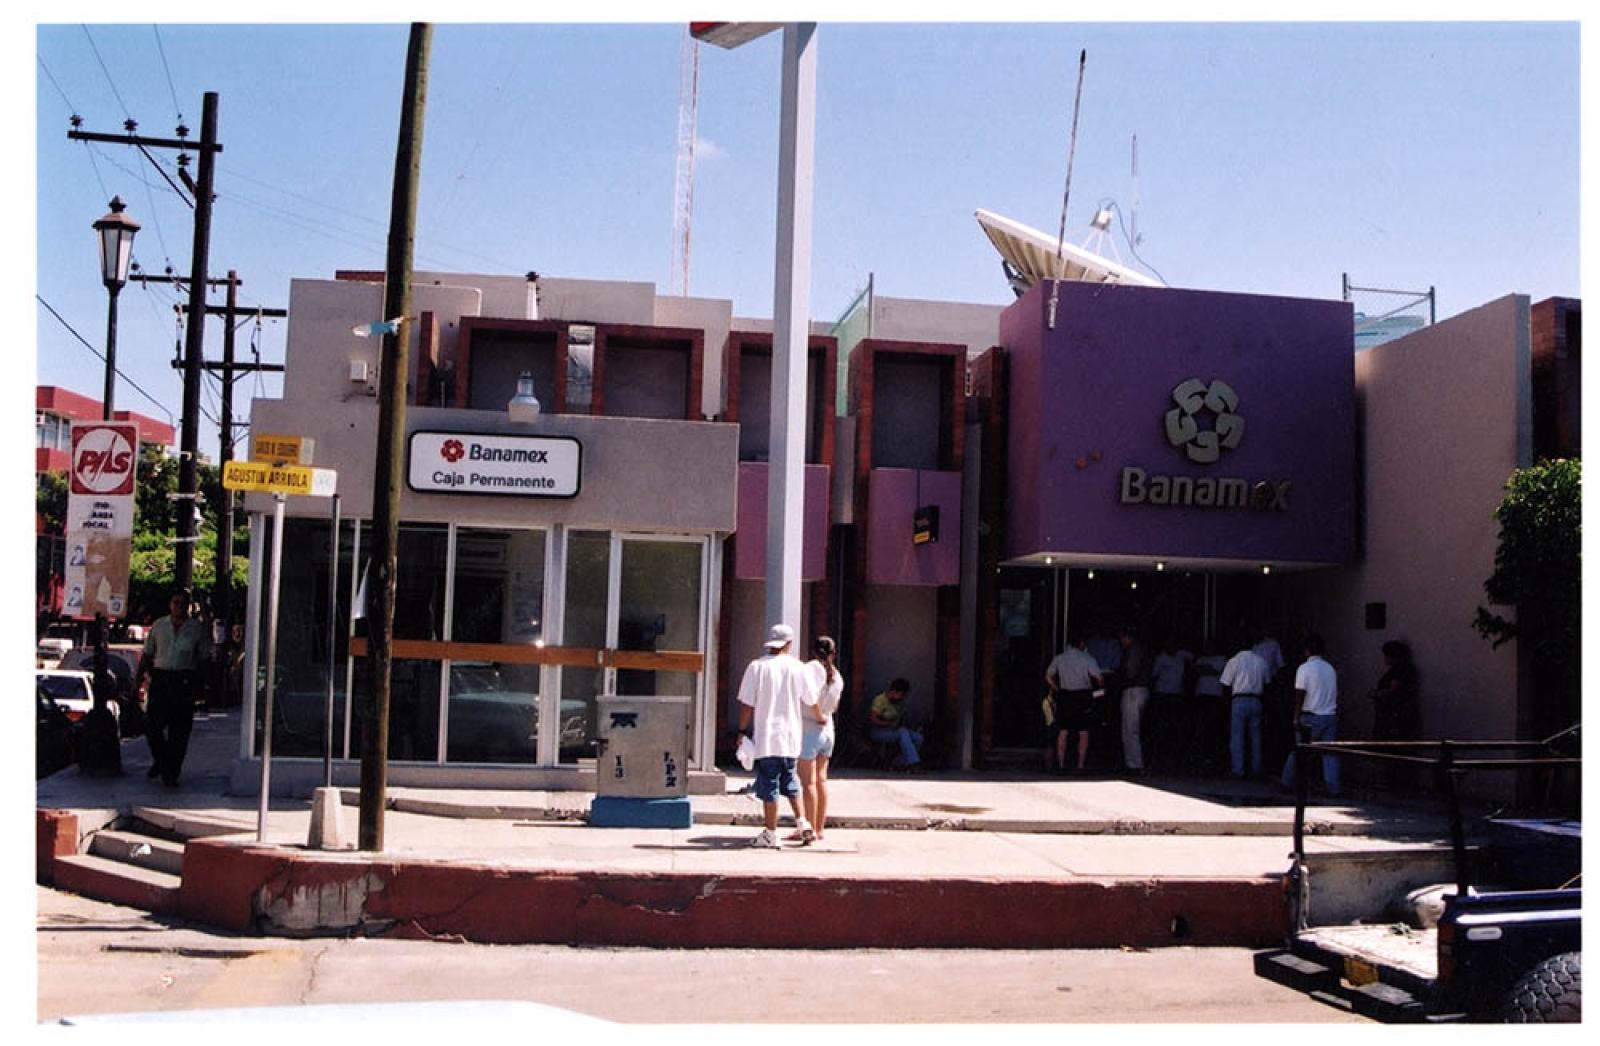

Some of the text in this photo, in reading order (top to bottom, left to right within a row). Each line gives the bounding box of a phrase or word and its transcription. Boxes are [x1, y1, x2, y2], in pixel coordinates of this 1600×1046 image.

[469, 443, 548, 463] Banamex
[227, 467, 265, 484] AGUSTIN
[432, 471, 555, 488] Caja Permanente
[1120, 466, 1291, 511] Banamex
